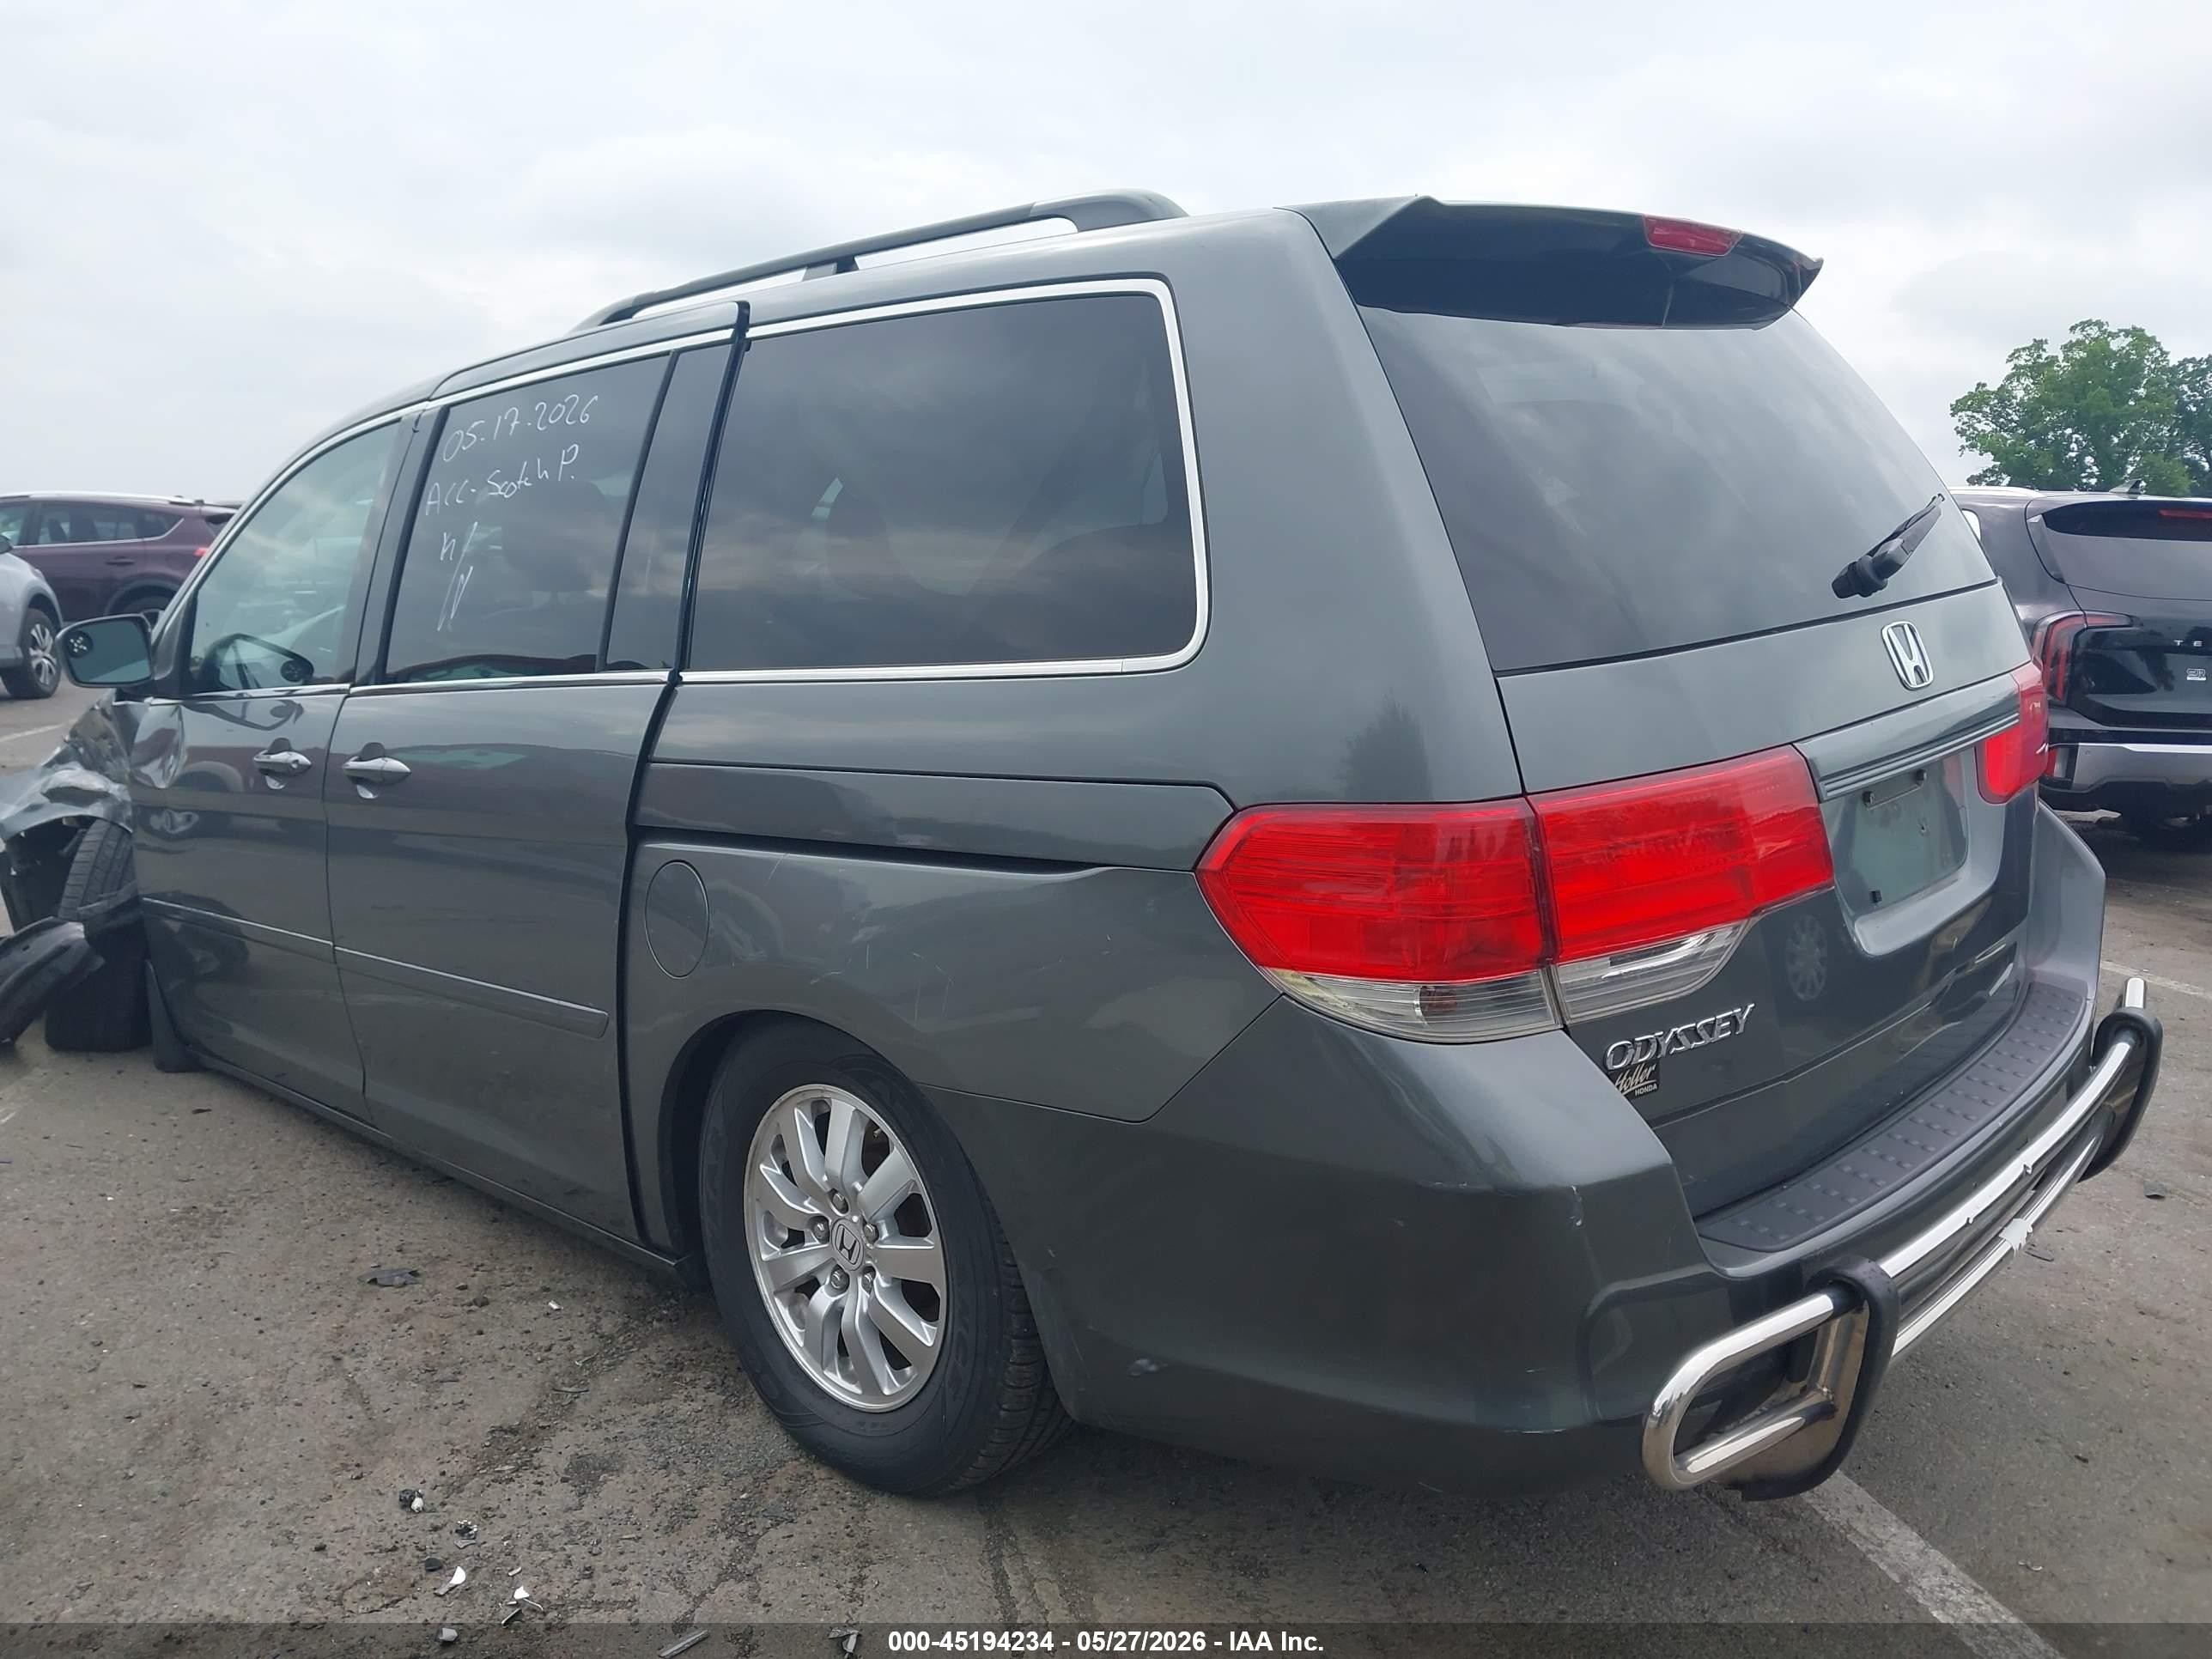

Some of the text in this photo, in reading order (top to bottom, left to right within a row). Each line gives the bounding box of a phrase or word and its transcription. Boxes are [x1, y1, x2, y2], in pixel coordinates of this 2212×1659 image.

[442, 394, 599, 462] 05.17.2026
[1606, 1003, 1755, 1070] ODYSSEY
[1614, 1062, 1657, 1092] Holler
[1634, 1083, 1657, 1097] HONDA
